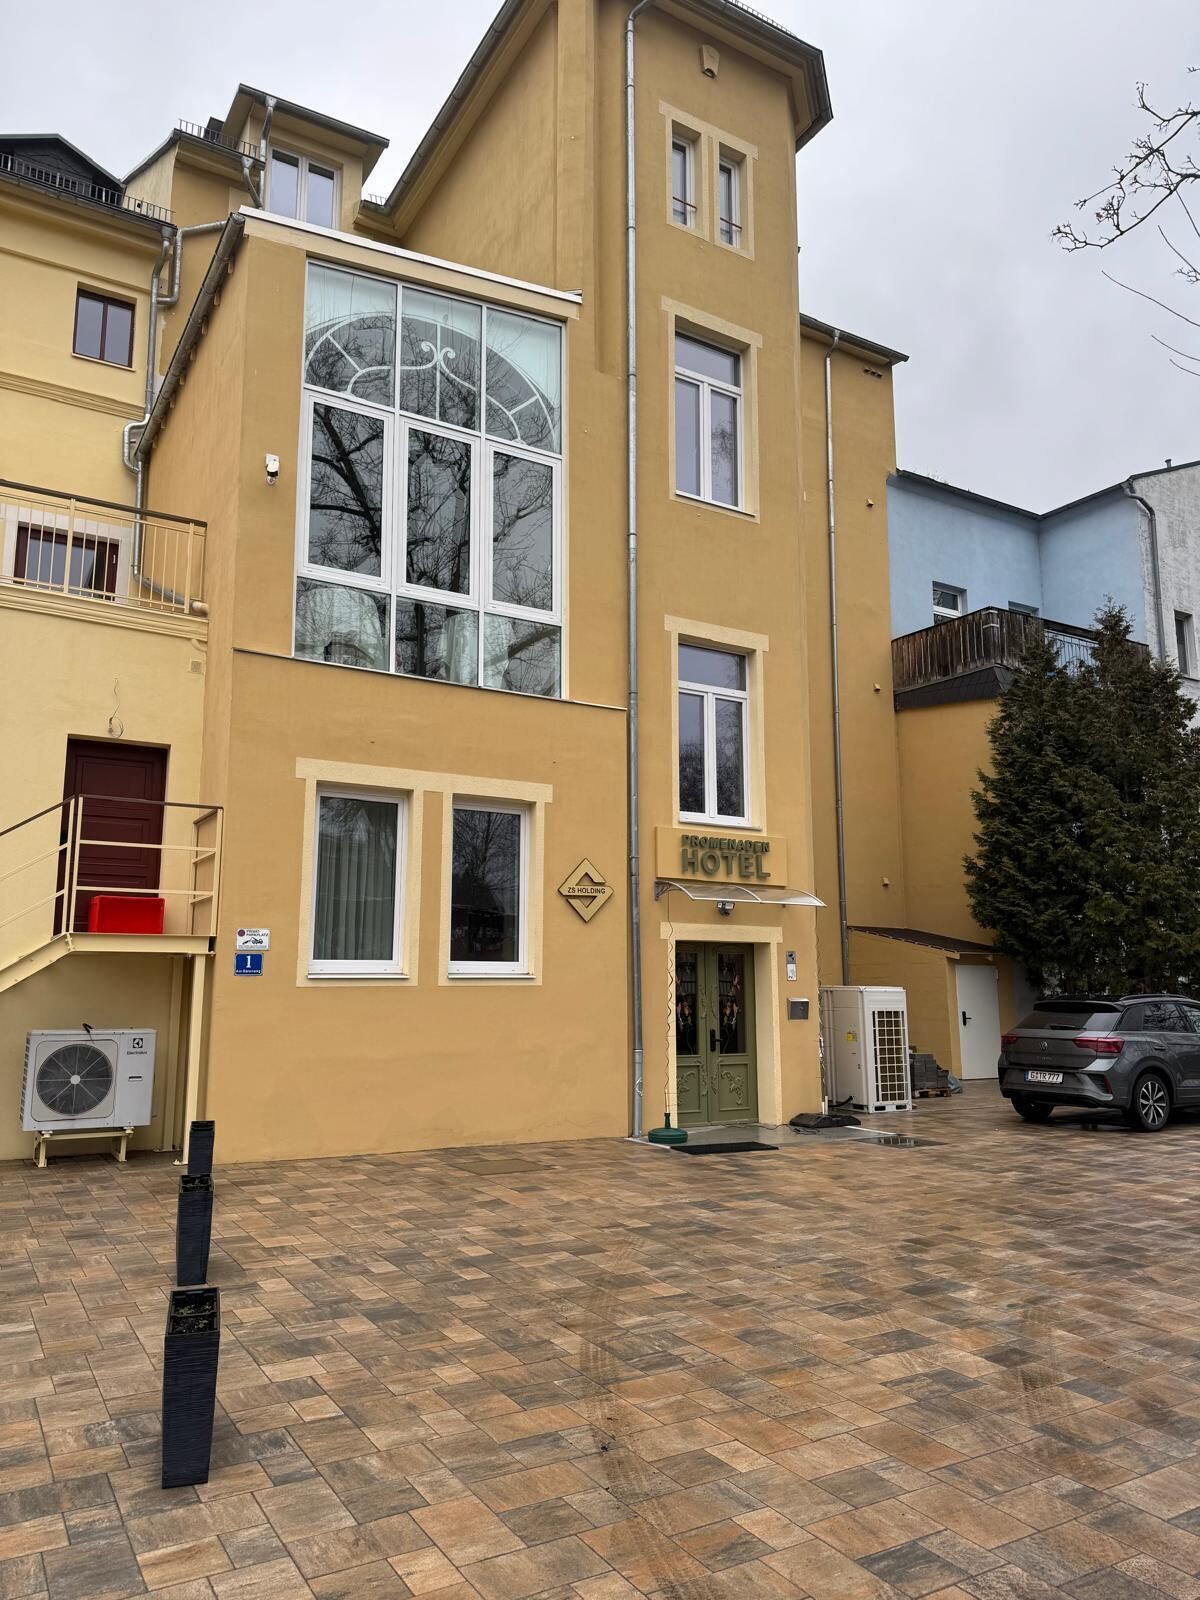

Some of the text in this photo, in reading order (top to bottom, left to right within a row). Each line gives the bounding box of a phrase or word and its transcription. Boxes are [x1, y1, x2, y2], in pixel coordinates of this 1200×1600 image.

[681, 834, 770, 852] PROMENADEN
[681, 848, 771, 878] HOTEL
[567, 886, 576, 894] ZS
[246, 955, 252, 969] 1
